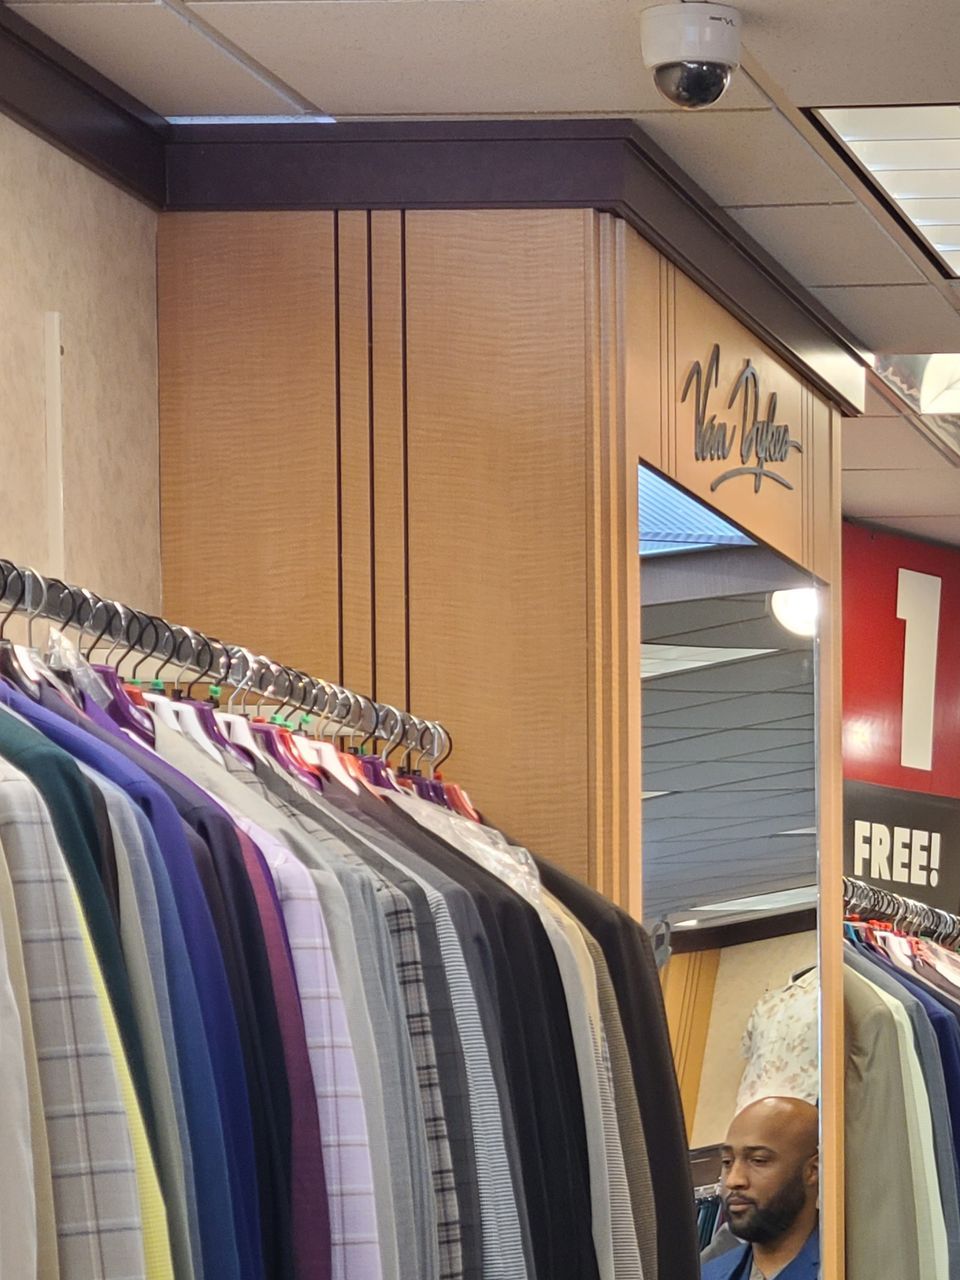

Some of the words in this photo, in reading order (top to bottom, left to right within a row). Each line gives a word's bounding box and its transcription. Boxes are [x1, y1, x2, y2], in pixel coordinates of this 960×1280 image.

[681, 343, 736, 461] Van
[896, 568, 941, 771] 1
[854, 820, 941, 887] FREE!
